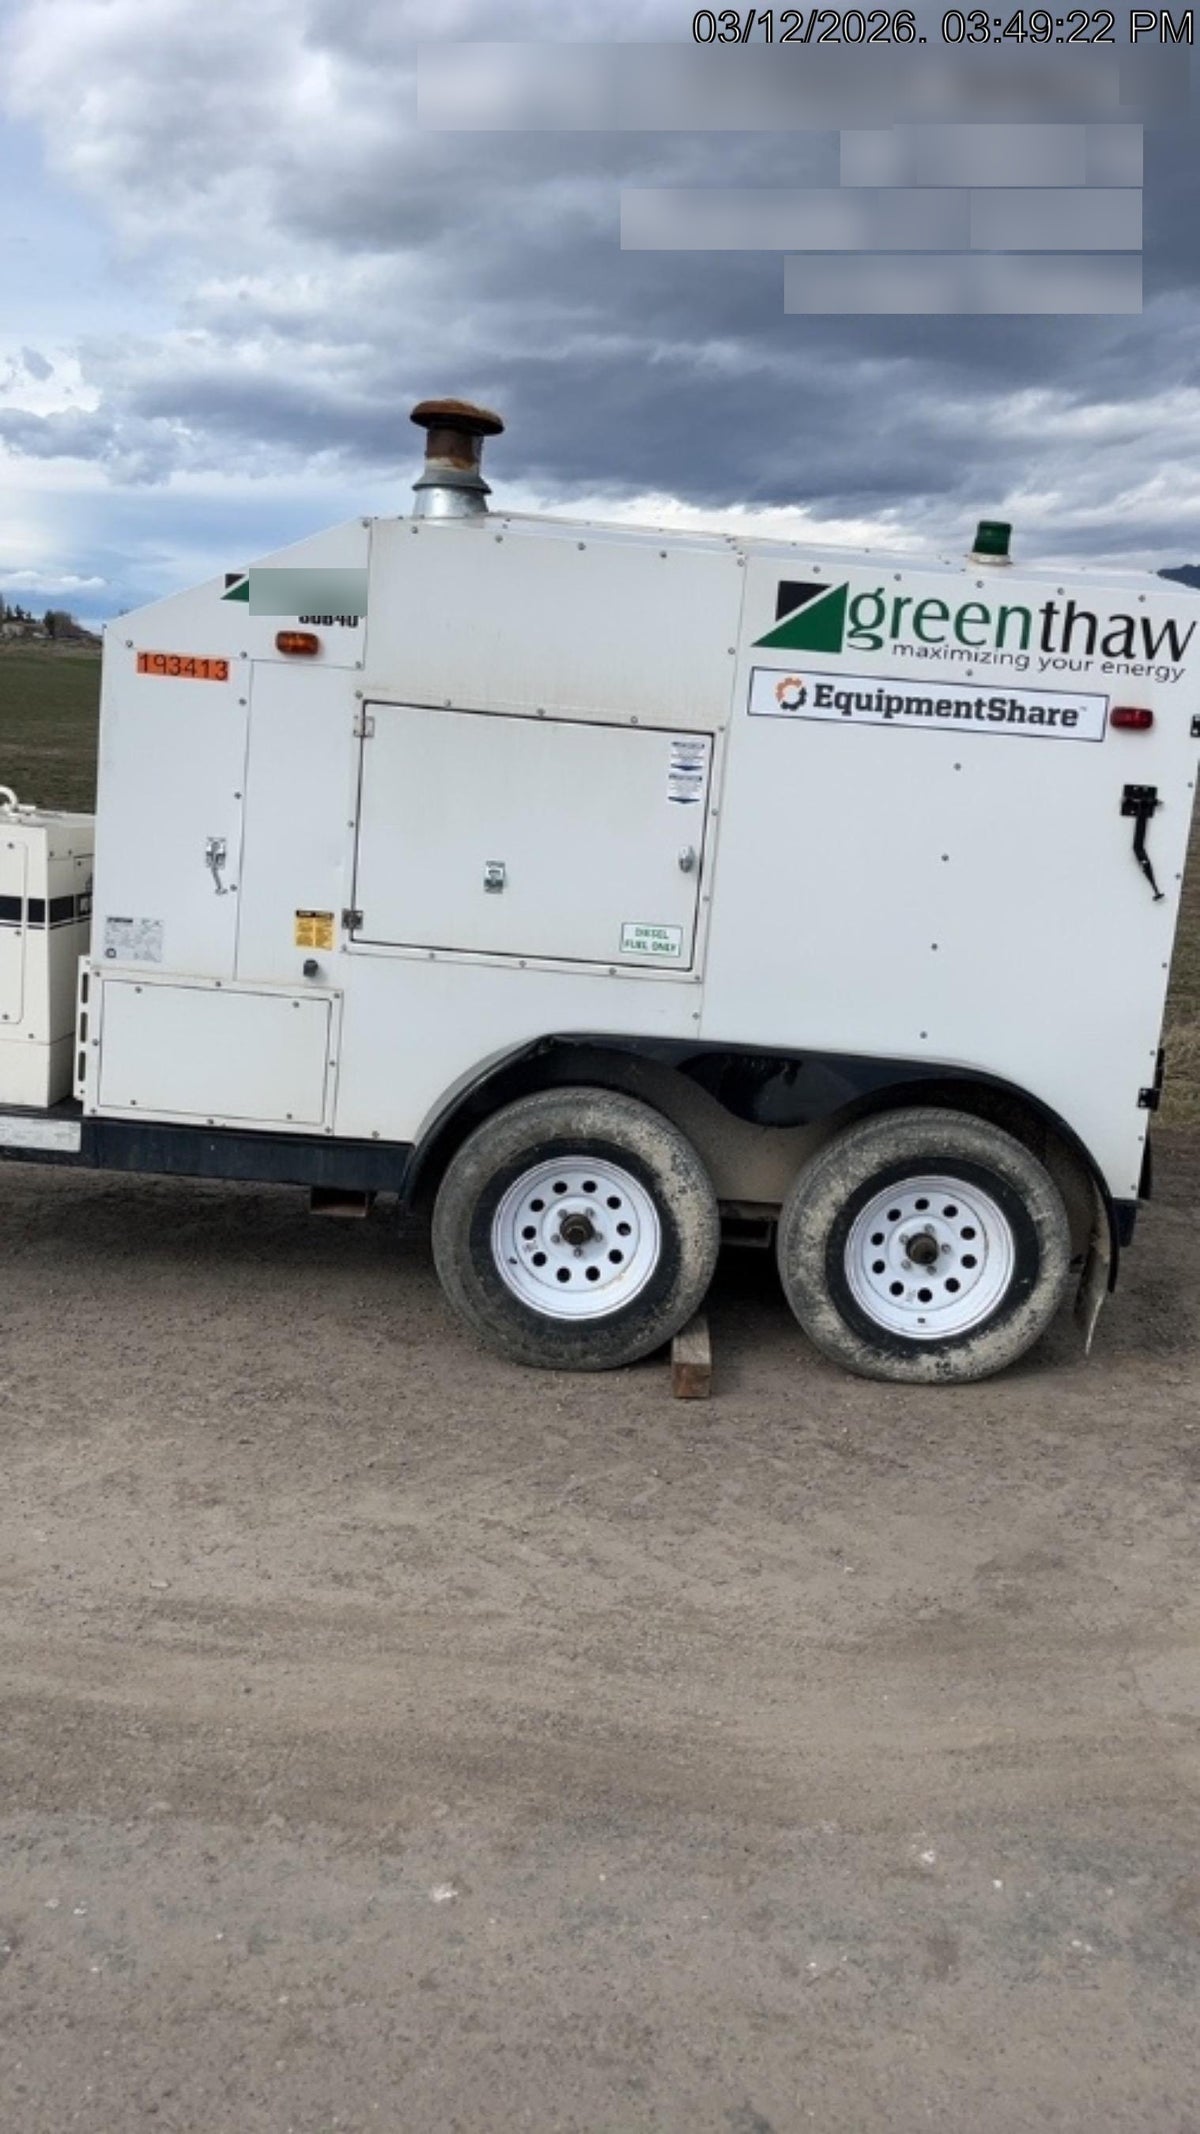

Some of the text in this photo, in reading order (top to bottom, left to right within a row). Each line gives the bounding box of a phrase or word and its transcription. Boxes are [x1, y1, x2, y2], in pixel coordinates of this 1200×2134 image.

[847, 586, 1197, 662] greenthaw
[139, 652, 229, 681] 193413
[892, 644, 1187, 683] maximizing your energy
[813, 683, 1079, 727] EquipmentShare
